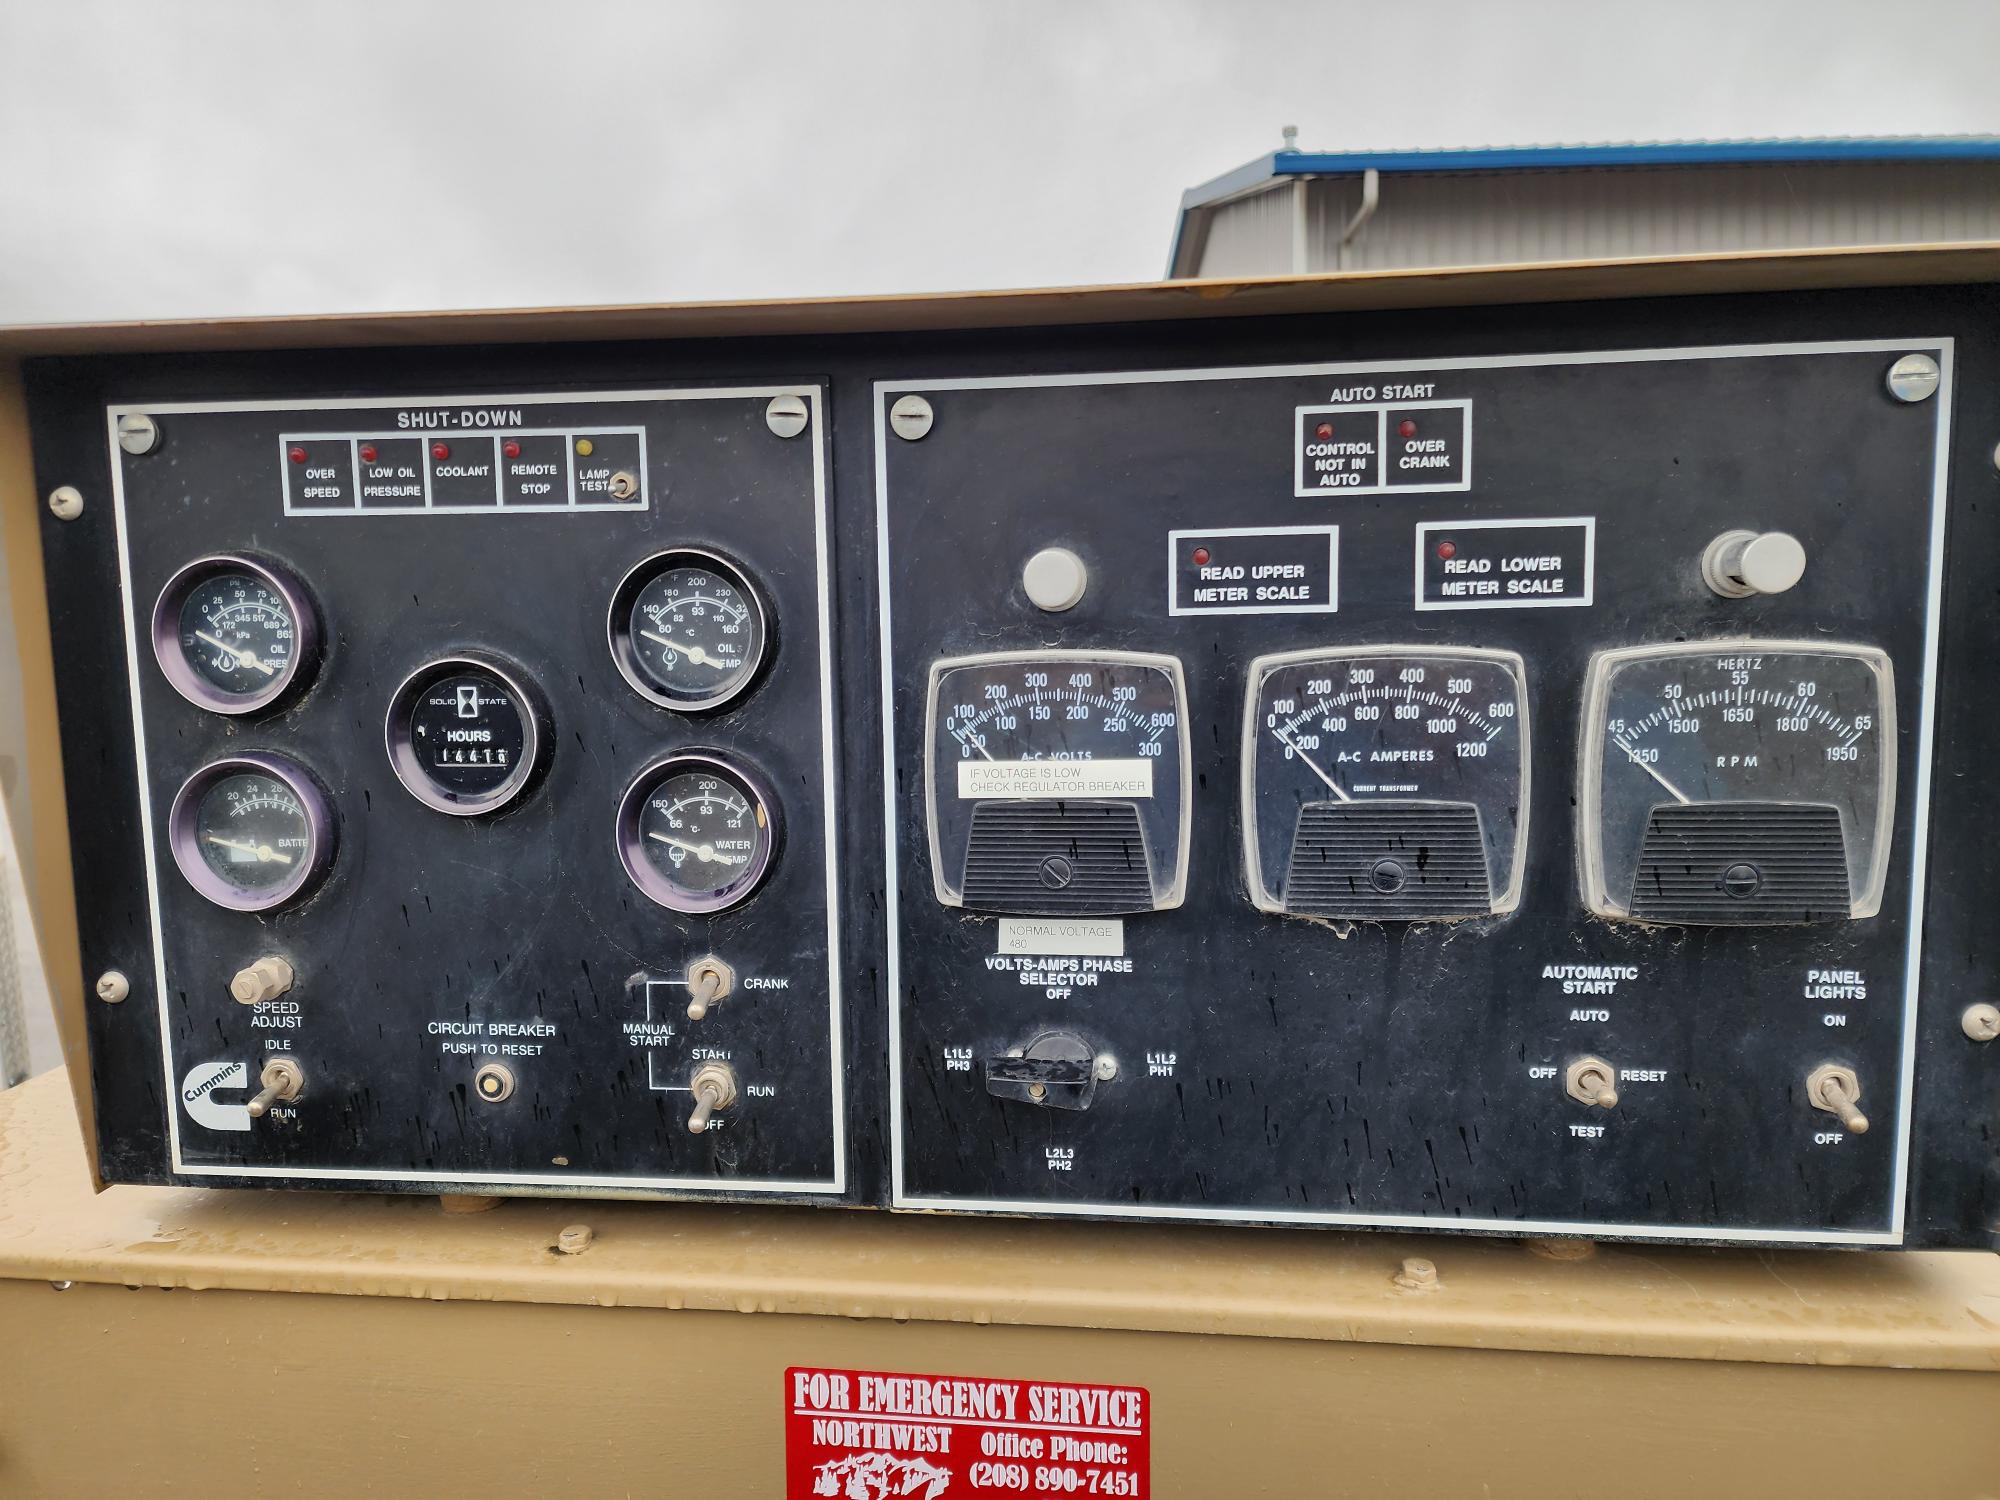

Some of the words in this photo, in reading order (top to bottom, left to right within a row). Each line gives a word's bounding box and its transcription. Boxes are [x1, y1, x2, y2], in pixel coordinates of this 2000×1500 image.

[1331, 387, 1375, 402] AUTO
[1383, 384, 1435, 399] START
[397, 410, 522, 428] SHUT-DOWN
[1306, 443, 1375, 456] CONTROL
[1405, 441, 1445, 453] OVER
[1315, 459, 1344, 471] NOT
[1352, 458, 1366, 469] IN
[1400, 456, 1449, 468] CRANK
[306, 469, 335, 479] OVER
[370, 468, 392, 478] LOW
[398, 468, 415, 478] OIL
[436, 465, 489, 477] COOLANT
[512, 464, 557, 475] REMOTE
[580, 469, 609, 479] LAMP
[1320, 474, 1360, 486] AUTO
[364, 487, 420, 496] PRESSURE
[521, 484, 550, 494] STOP
[580, 482, 608, 491] TEST
[304, 488, 340, 498] SPEED
[1445, 559, 1491, 573] READ
[1501, 557, 1561, 572] LOWER
[1201, 566, 1244, 580] READ
[1252, 565, 1304, 579] UPPER
[1442, 581, 1499, 595] METER
[1507, 579, 1564, 593] SCALE
[1194, 588, 1248, 602] METER
[1256, 586, 1309, 600] SCALE
[642, 605, 659, 613] 140
[659, 625, 671, 633] 60
[722, 625, 739, 633] 160
[271, 645, 285, 653] OIL
[718, 644, 735, 652] OIL
[1718, 659, 1762, 669] HERTZ
[947, 718, 954, 730] 0
[954, 705, 974, 718] 100
[985, 685, 1007, 699] 200
[1025, 674, 1047, 687] 300
[1069, 674, 1091, 687] 400
[1113, 687, 1136, 701] 500
[1151, 713, 1174, 727] 600
[1268, 716, 1275, 727] 0
[1273, 700, 1294, 714] 100
[1308, 680, 1331, 694] 200
[1351, 669, 1374, 683] 300
[1400, 669, 1424, 682] 400
[1448, 680, 1471, 693] 500
[1489, 703, 1513, 717] 600
[1609, 720, 1624, 733] 45
[1665, 685, 1681, 699] 50
[1732, 671, 1749, 685] 55
[1798, 683, 1815, 696] 60
[1855, 717, 1871, 730] 65
[447, 731, 491, 741] HOURS
[963, 746, 969, 758] 0
[995, 717, 1016, 730] 100
[1029, 706, 1050, 720] 150
[1067, 706, 1088, 720] 200
[1104, 718, 1126, 732] 250
[1139, 743, 1161, 757] 300
[1285, 747, 1292, 759] 0
[1296, 736, 1319, 749] 200
[1322, 718, 1346, 731] 400
[1355, 706, 1378, 720] 600
[1395, 705, 1419, 719] 800
[1427, 720, 1456, 733] 1000
[1456, 743, 1486, 757] 1200
[1668, 720, 1699, 733] 1500
[1723, 709, 1753, 722] 1650
[1777, 718, 1808, 731] 1800
[1827, 747, 1857, 761] 1950
[1051, 752, 1091, 761] VOLTS
[1338, 752, 1361, 762] A-C
[1370, 751, 1434, 761] AMPERES
[970, 769, 980, 778] IF
[983, 769, 1036, 778] VOLTAGE
[1041, 769, 1050, 777] IS
[1054, 768, 1081, 777] LOW
[971, 783, 1010, 792] CHECK
[1014, 783, 1085, 791] REGULATOR
[1089, 782, 1145, 791] BREAKER
[670, 820, 682, 828] 66
[700, 806, 712, 814] 93
[727, 820, 741, 828] 121
[716, 841, 750, 849] WATER
[1010, 926, 1056, 935] NORMAL
[1060, 927, 1112, 936] VOLTAGE
[1010, 940, 1026, 948] 480
[985, 959, 1078, 971] VOLTS-AMPS
[1083, 960, 1132, 972] PHASE
[1542, 966, 1638, 980] AUTOMATIC
[1808, 971, 1864, 984] PANEL
[744, 979, 788, 989] CRANK
[1020, 973, 1097, 986] SELECTOR
[1563, 982, 1617, 994] START
[1805, 986, 1866, 999] LIGHTS
[1046, 989, 1071, 999] OFF
[253, 1002, 299, 1013] SPEED
[1570, 1010, 1610, 1022] AUTO
[1824, 1016, 1846, 1026] ON
[251, 1017, 303, 1028] ADJUST
[428, 1022, 483, 1034] CIRCUIT
[489, 1024, 555, 1036] BREAKER
[623, 1024, 675, 1035] MANUAL
[265, 1040, 291, 1050] IDLE
[630, 1036, 670, 1046] START
[442, 1043, 476, 1053] PUSH
[481, 1044, 497, 1054] TO
[502, 1045, 543, 1056] RESET
[945, 1049, 972, 1059] L1L3
[1147, 1054, 1176, 1064] L1L2
[947, 1062, 970, 1071] PH3
[1150, 1066, 1173, 1076] PH1
[1529, 1068, 1557, 1079] OFF
[1621, 1071, 1667, 1081] RESET
[184, 1062, 241, 1101] Cummins
[748, 1087, 774, 1096] RUN
[271, 1109, 296, 1118] RUN
[1569, 1126, 1605, 1137] TEST
[1815, 1133, 1843, 1144] OFF
[1046, 1149, 1074, 1158] L2L3
[1048, 1161, 1071, 1170] PH2
[794, 1373, 850, 1410] FOR
[858, 1376, 1019, 1420] EMERGENCY
[1028, 1386, 1141, 1428] SERVICE
[813, 1420, 951, 1452] NORTHWEST
[981, 1432, 1043, 1458] Office
[1050, 1437, 1127, 1463] Phone:
[969, 1462, 1028, 1492] (208)
[1035, 1467, 1138, 1496] 890-7451
